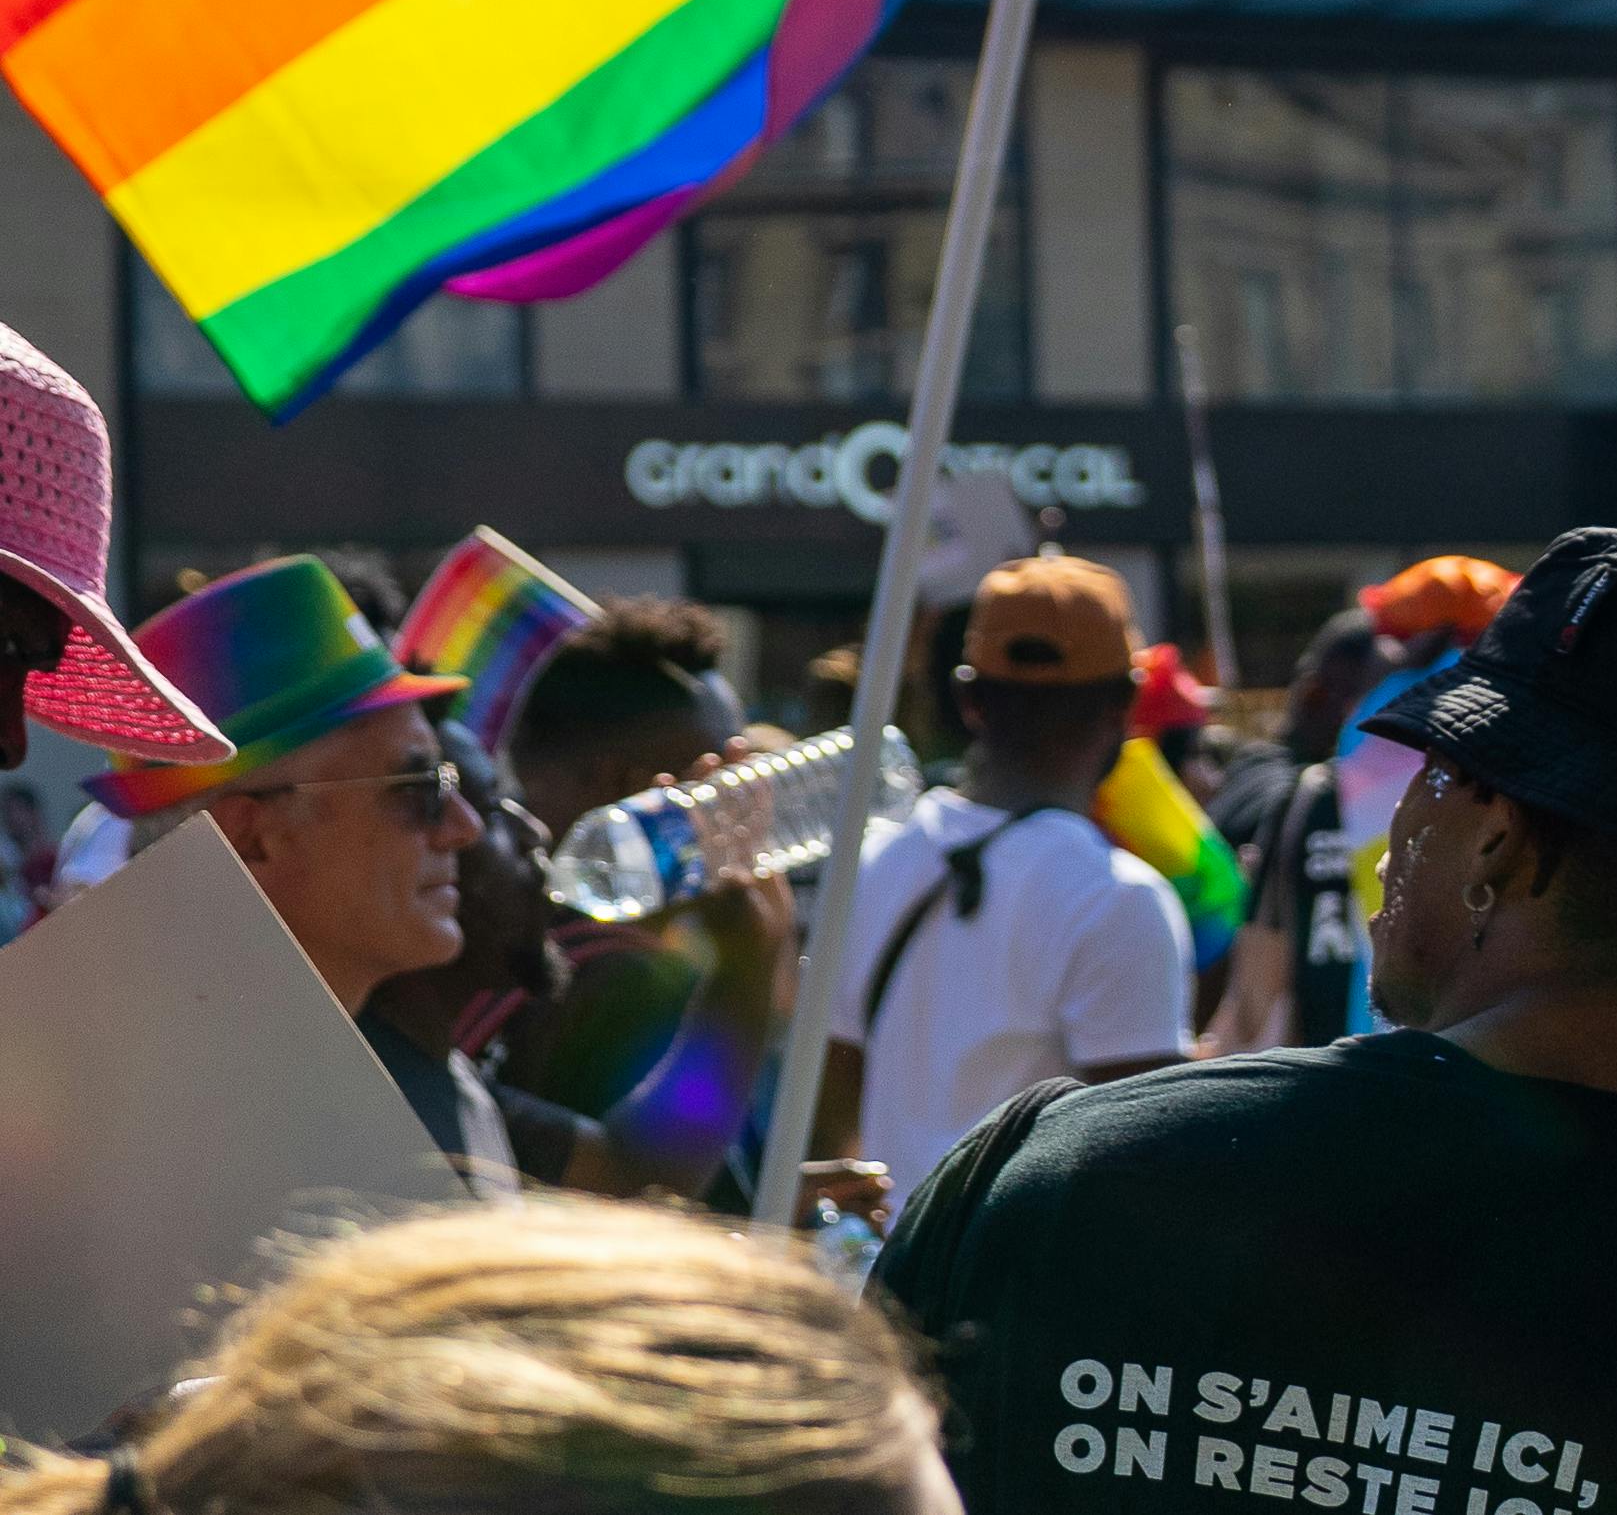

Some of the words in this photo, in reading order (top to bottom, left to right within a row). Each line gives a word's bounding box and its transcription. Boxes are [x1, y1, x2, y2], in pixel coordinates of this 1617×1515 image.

[1053, 1423, 1168, 1481] ON
[1194, 1435, 1441, 1515] RESTE
[1060, 1358, 1173, 1417] ON
[1193, 1371, 1456, 1465] S'AIME
[1473, 1420, 1599, 1509] ICI,
